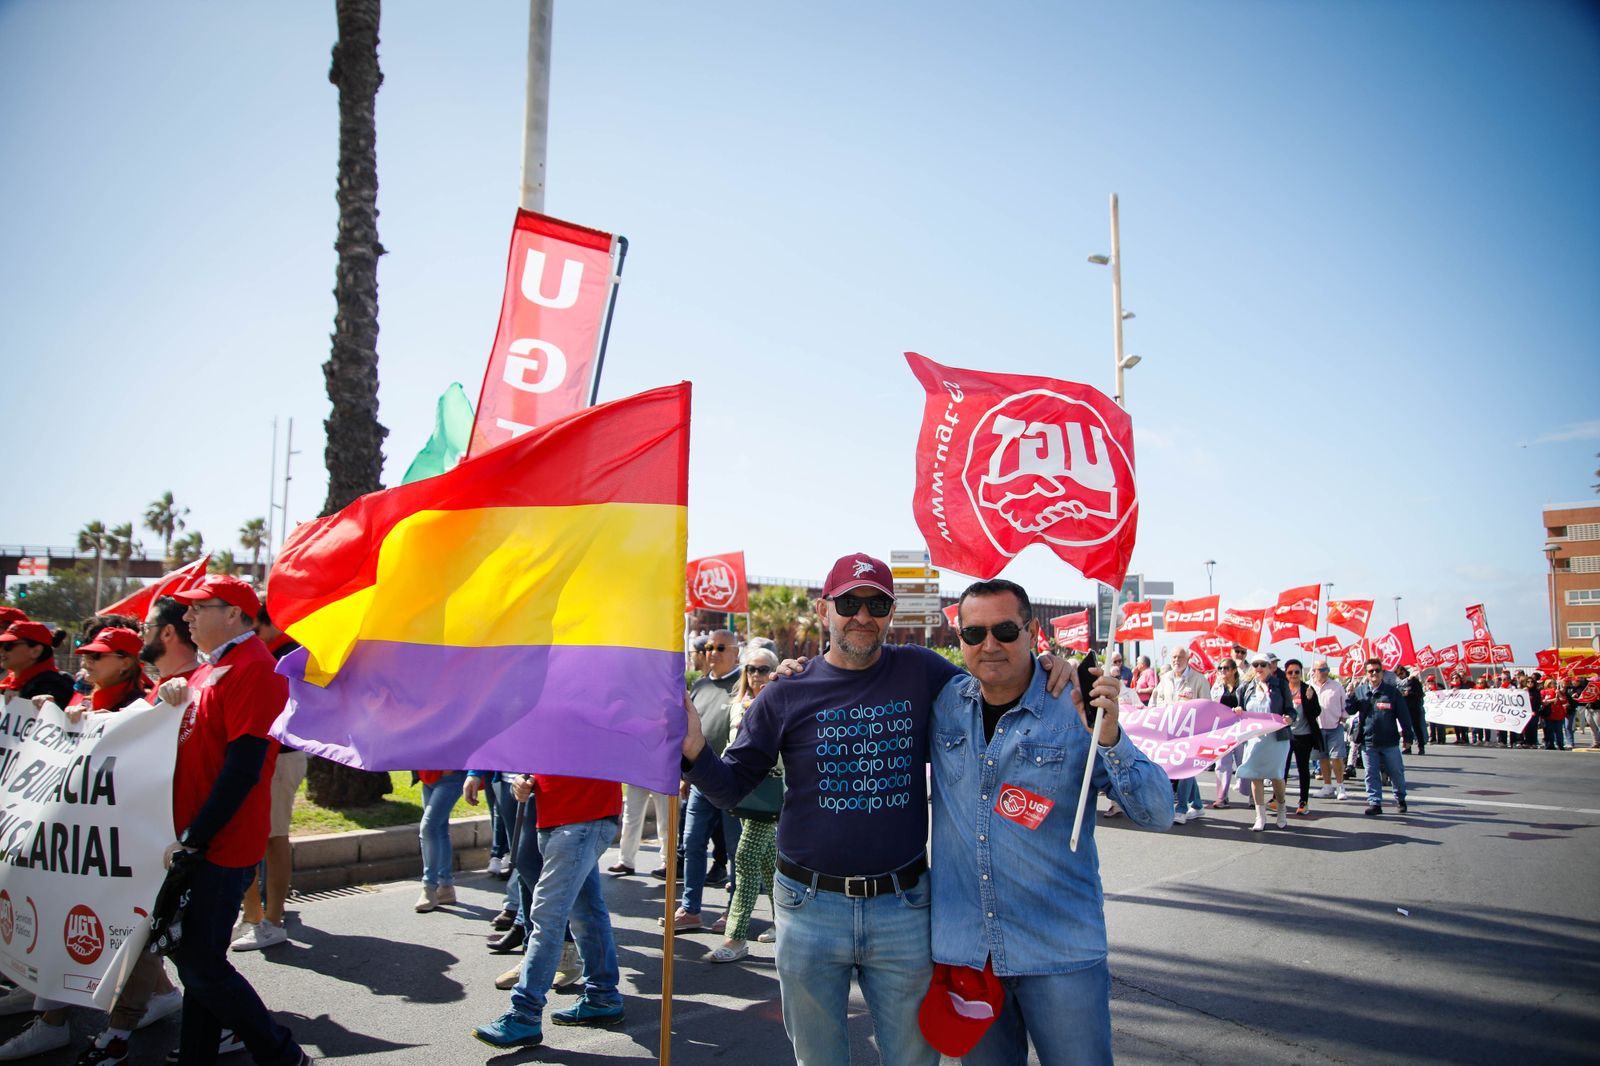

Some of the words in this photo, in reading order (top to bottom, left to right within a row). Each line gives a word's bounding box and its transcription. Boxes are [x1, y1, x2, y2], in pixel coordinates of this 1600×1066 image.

[816, 709, 847, 722] don
[849, 700, 912, 721] algodon
[1469, 701, 1528, 719] SERVICIOS
[816, 740, 848, 756] don
[852, 734, 913, 757] algodon
[819, 776, 849, 792] don
[852, 772, 911, 794] algodon
[1028, 800, 1050, 814] UGT
[67, 914, 98, 940] UGT
